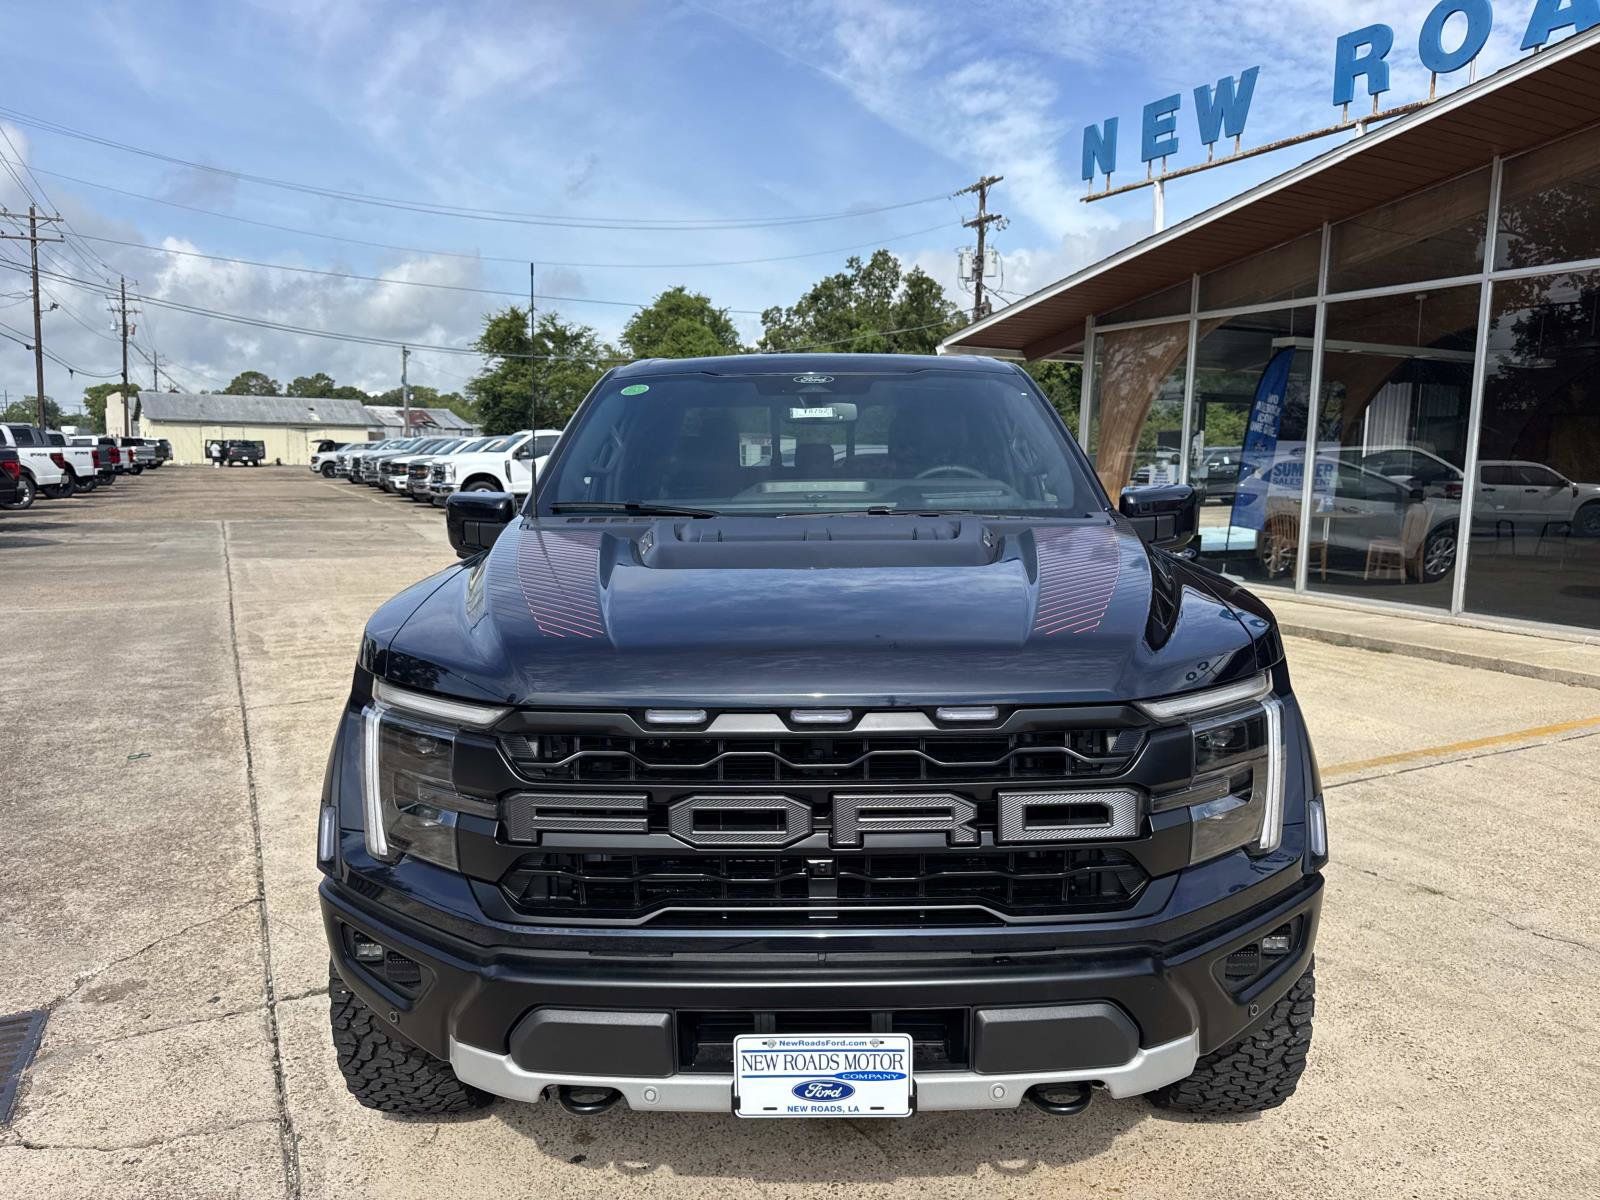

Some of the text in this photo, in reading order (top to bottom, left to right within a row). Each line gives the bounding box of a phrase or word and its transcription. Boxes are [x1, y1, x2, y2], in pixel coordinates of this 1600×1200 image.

[1082, 65, 1260, 181] NEW
[1273, 462, 1334, 478] SUMER
[507, 788, 1142, 850] FORD
[779, 1039, 867, 1047] NewRoadsFord.com
[742, 1053, 904, 1071] NEW ROADS MOTOR
[804, 1082, 843, 1098] Ford
[787, 1105, 860, 1114] NEW ROADS, LA
